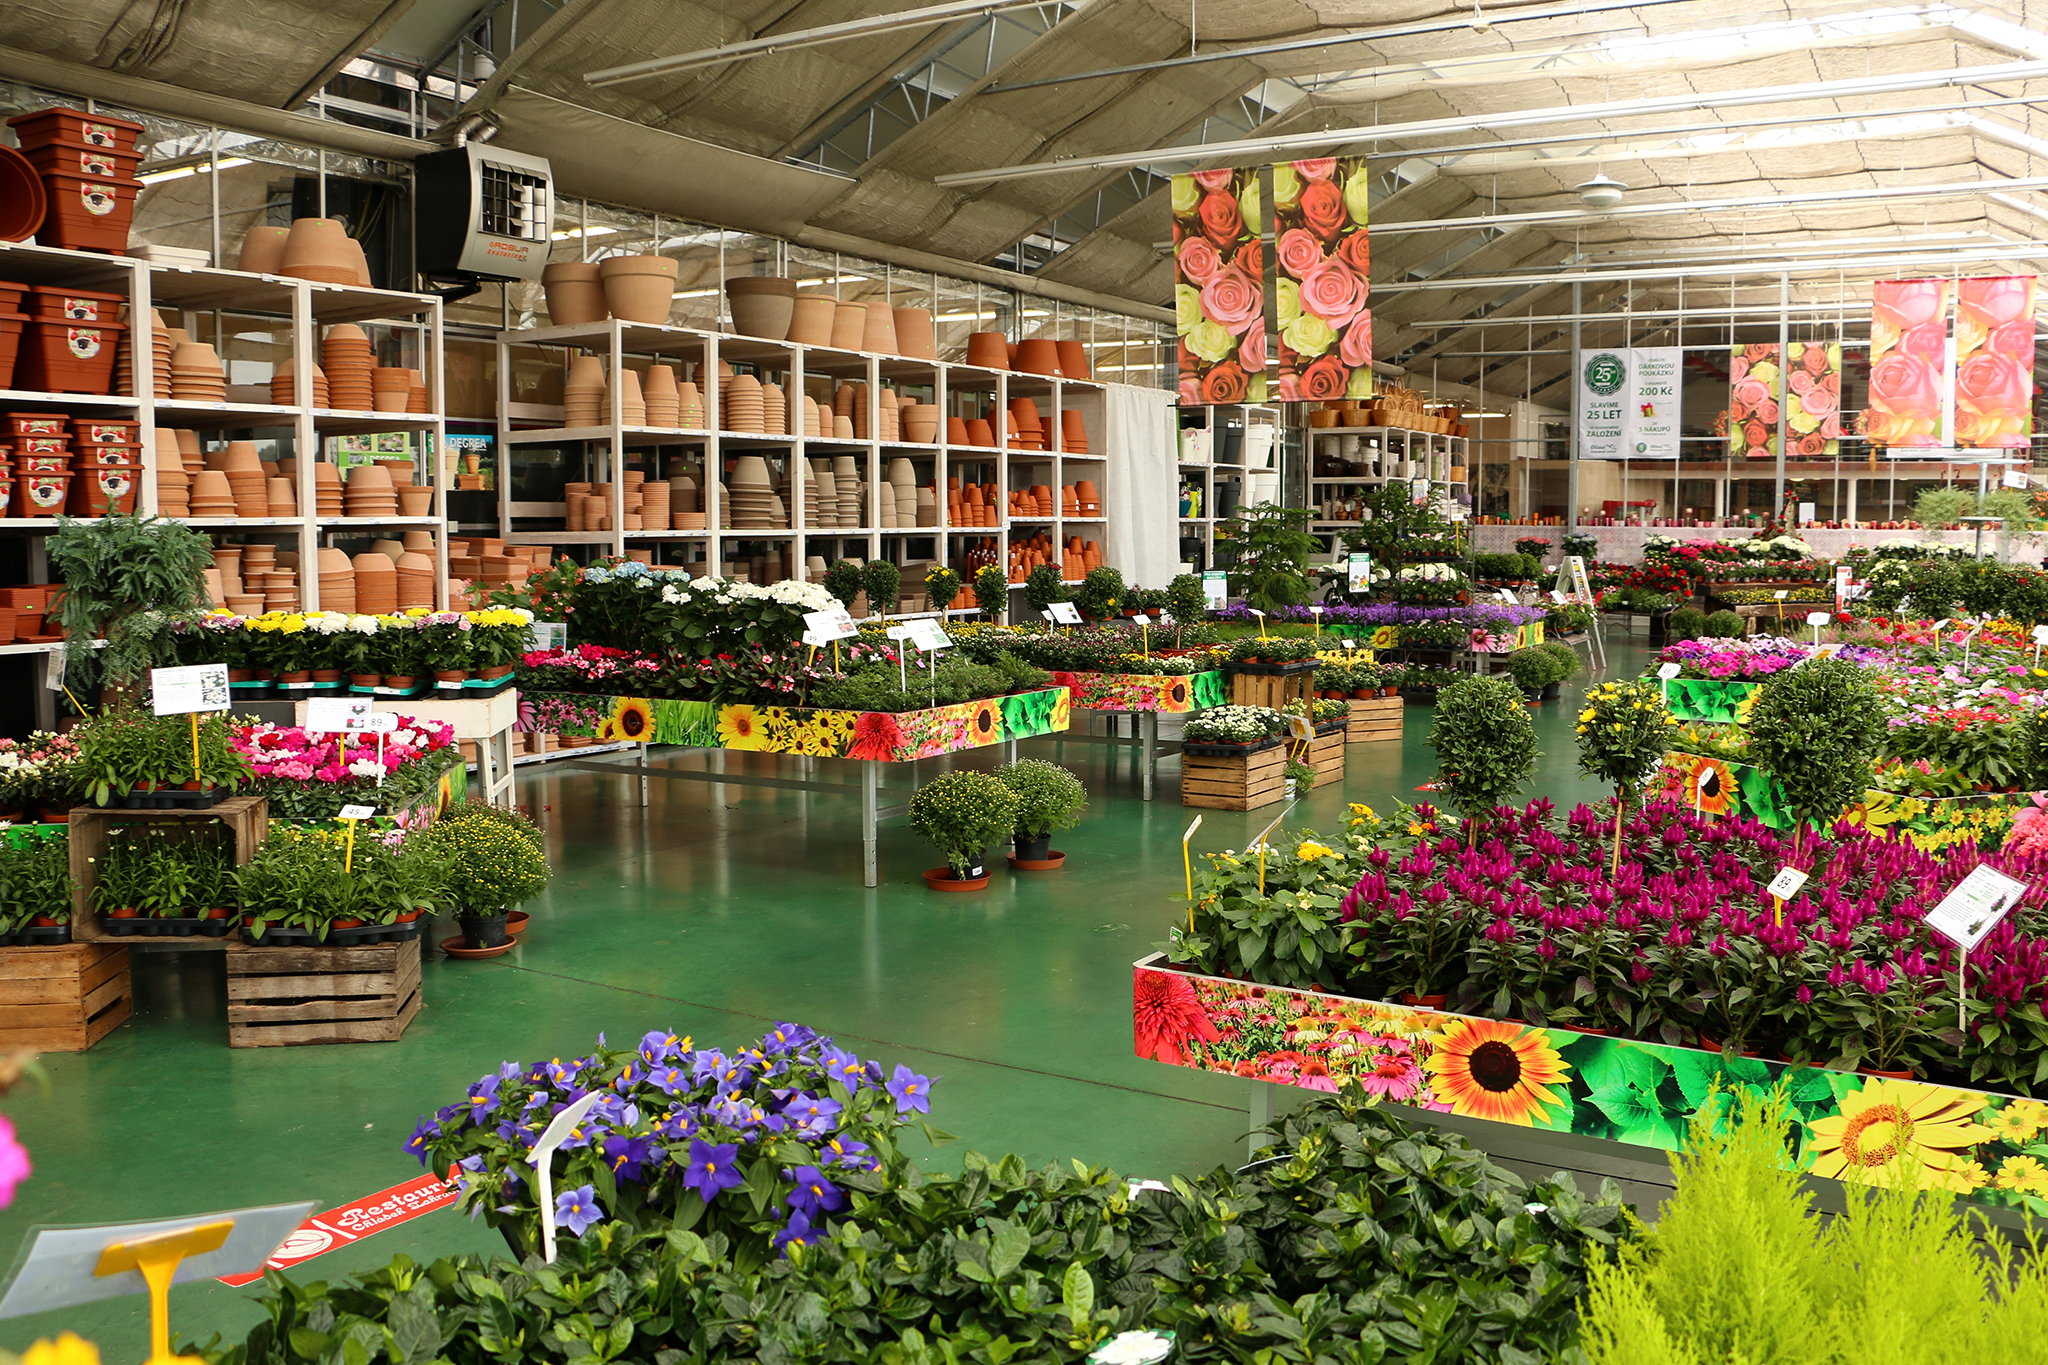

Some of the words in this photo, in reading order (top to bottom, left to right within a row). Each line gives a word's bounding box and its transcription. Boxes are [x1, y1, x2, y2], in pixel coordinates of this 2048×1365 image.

[1595, 367, 1611, 382] 25
[1638, 387, 1658, 396] 200
[1661, 386, 1673, 396] Kč
[1590, 401, 1619, 409] SLAVÍME
[1587, 411, 1600, 420] 25
[1603, 409, 1622, 420] LET
[1586, 429, 1622, 438] ZALOŽENÍ
[449, 437, 487, 449] DEGREA
[370, 718, 382, 726] 89
[1777, 876, 1791, 889] 89
